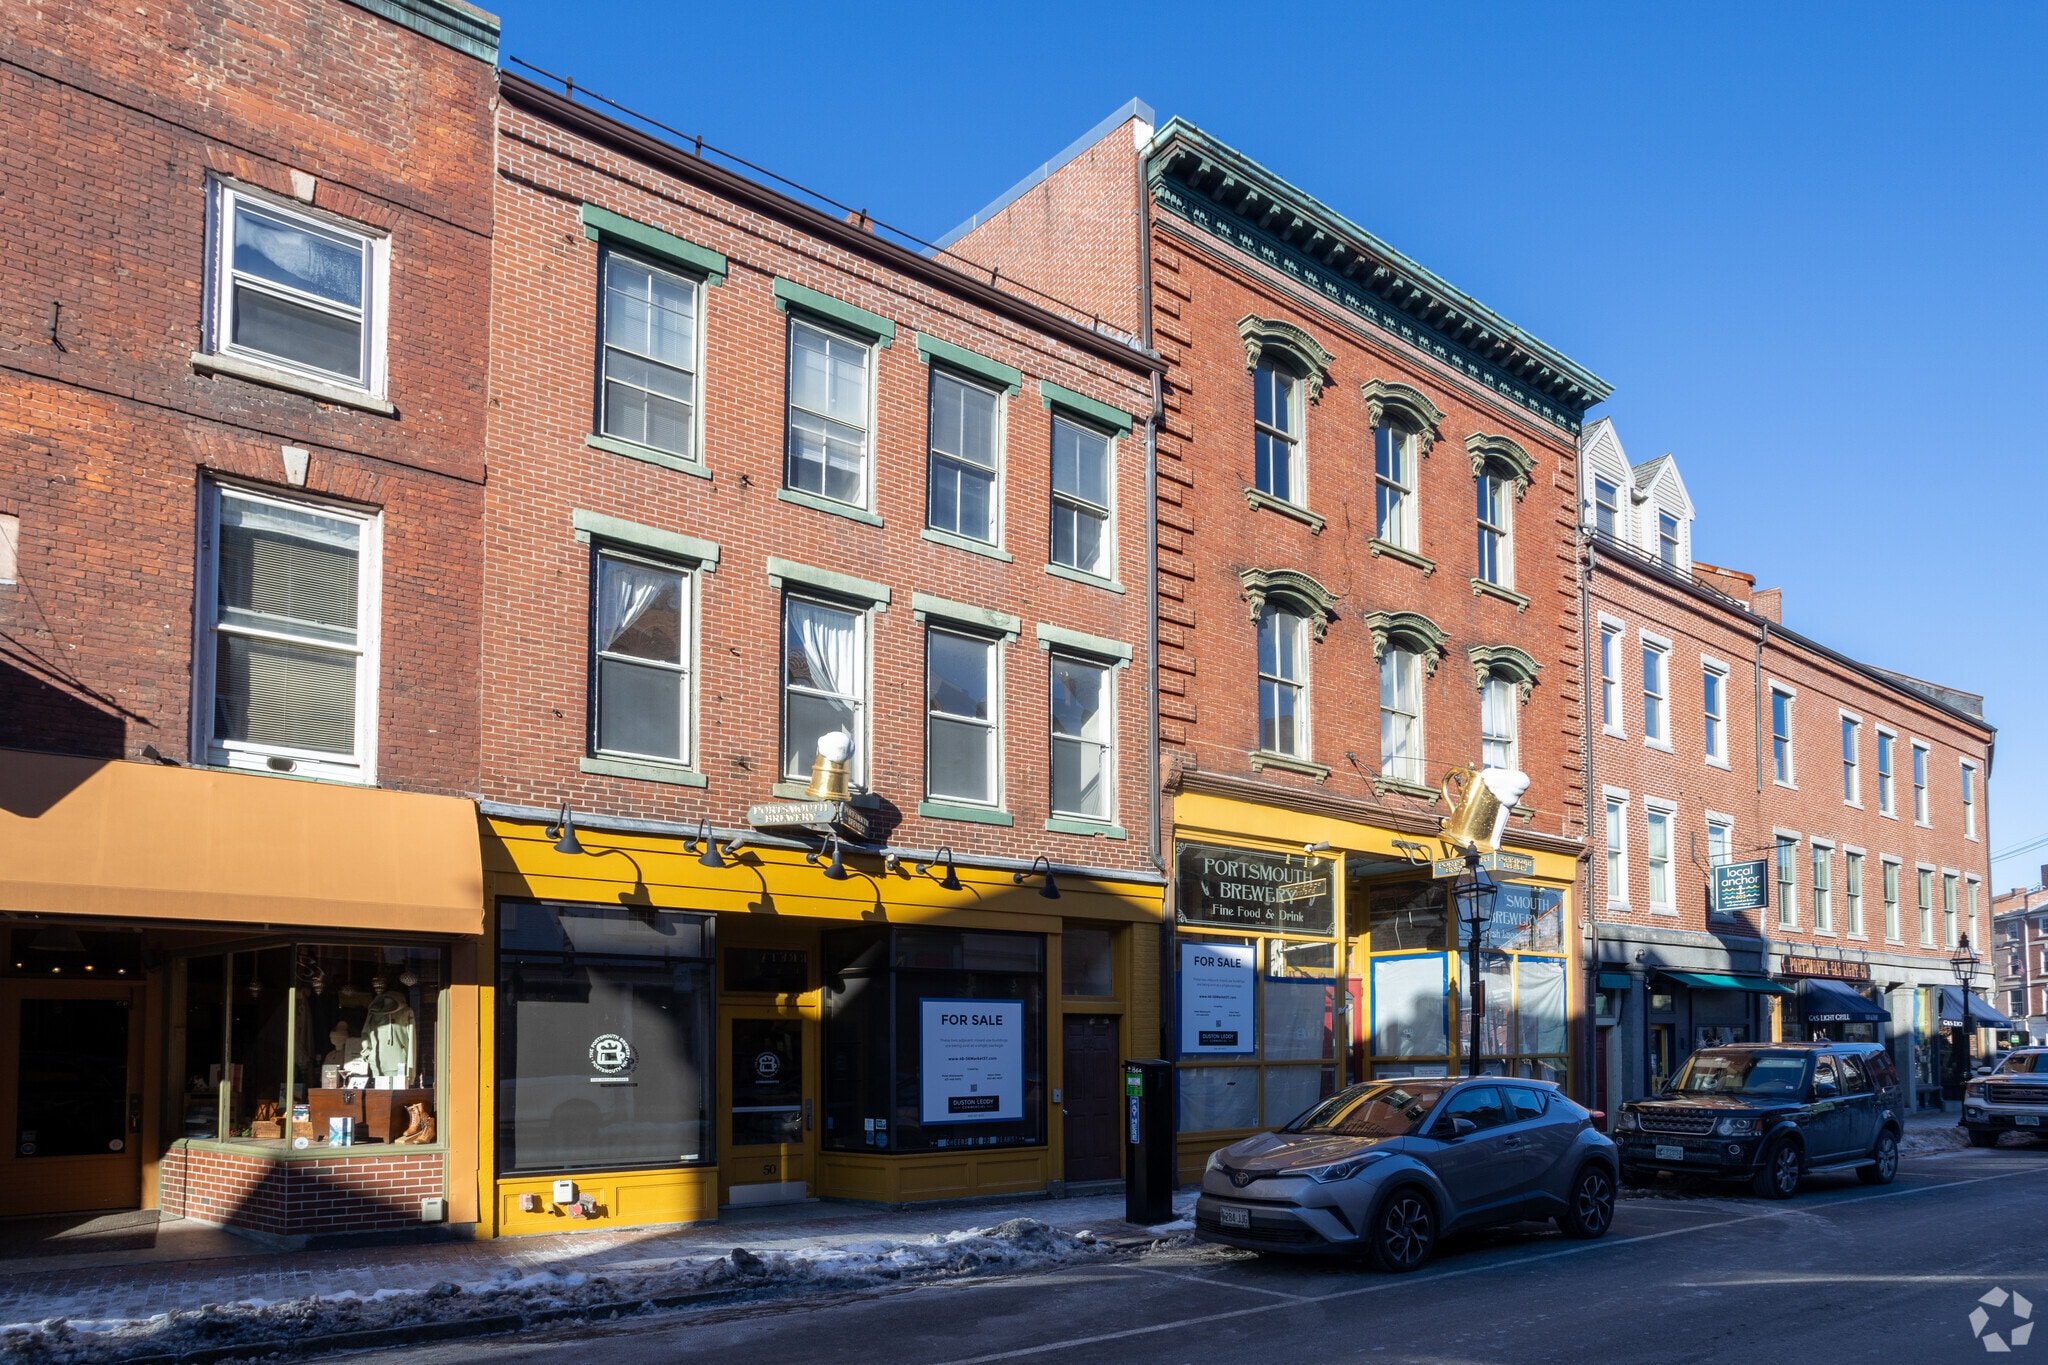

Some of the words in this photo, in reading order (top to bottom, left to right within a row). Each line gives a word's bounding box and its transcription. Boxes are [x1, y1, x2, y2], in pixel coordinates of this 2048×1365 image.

[753, 803, 828, 815] PORTSMOUTH
[765, 812, 816, 823] BREWERY
[1204, 858, 1312, 884] PORTSMOUTH
[1726, 865, 1753, 878] local
[1721, 875, 1760, 886] anchor
[1220, 882, 1297, 904] BREWERY
[1212, 904, 1234, 916] Fine
[1238, 906, 1260, 918] Food
[1266, 908, 1274, 920] &
[1280, 910, 1304, 922] Drink
[1194, 956, 1214, 966] FOR
[1218, 958, 1242, 968] SALE
[942, 1014, 968, 1026] FOR
[972, 1015, 1003, 1026] SALE
[763, 1164, 776, 1175] 50
